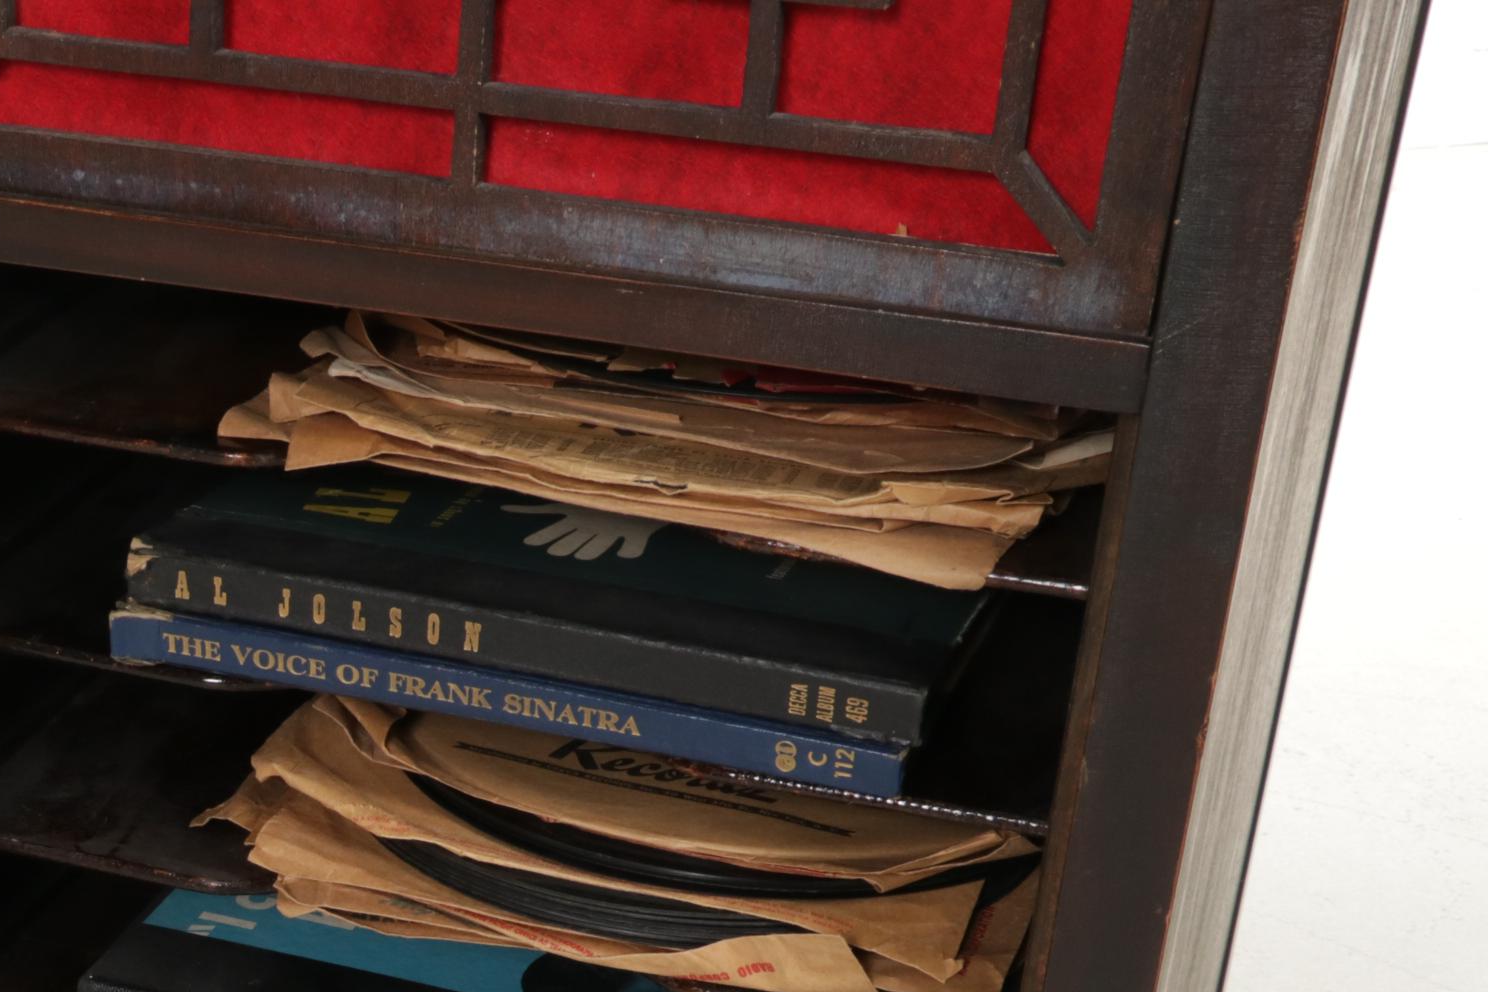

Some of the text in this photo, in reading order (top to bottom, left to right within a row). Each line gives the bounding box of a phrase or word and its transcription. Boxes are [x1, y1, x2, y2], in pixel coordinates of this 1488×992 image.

[175, 570, 482, 654] AL JOLSON
[162, 632, 641, 737] THE VOICE OF FRANK SINATRA
[787, 683, 809, 717] DECCA
[815, 685, 837, 723] ALBUM
[844, 696, 869, 724] 469
[806, 750, 829, 769] C
[833, 747, 856, 779] 112
[737, 962, 775, 979] RADIO
